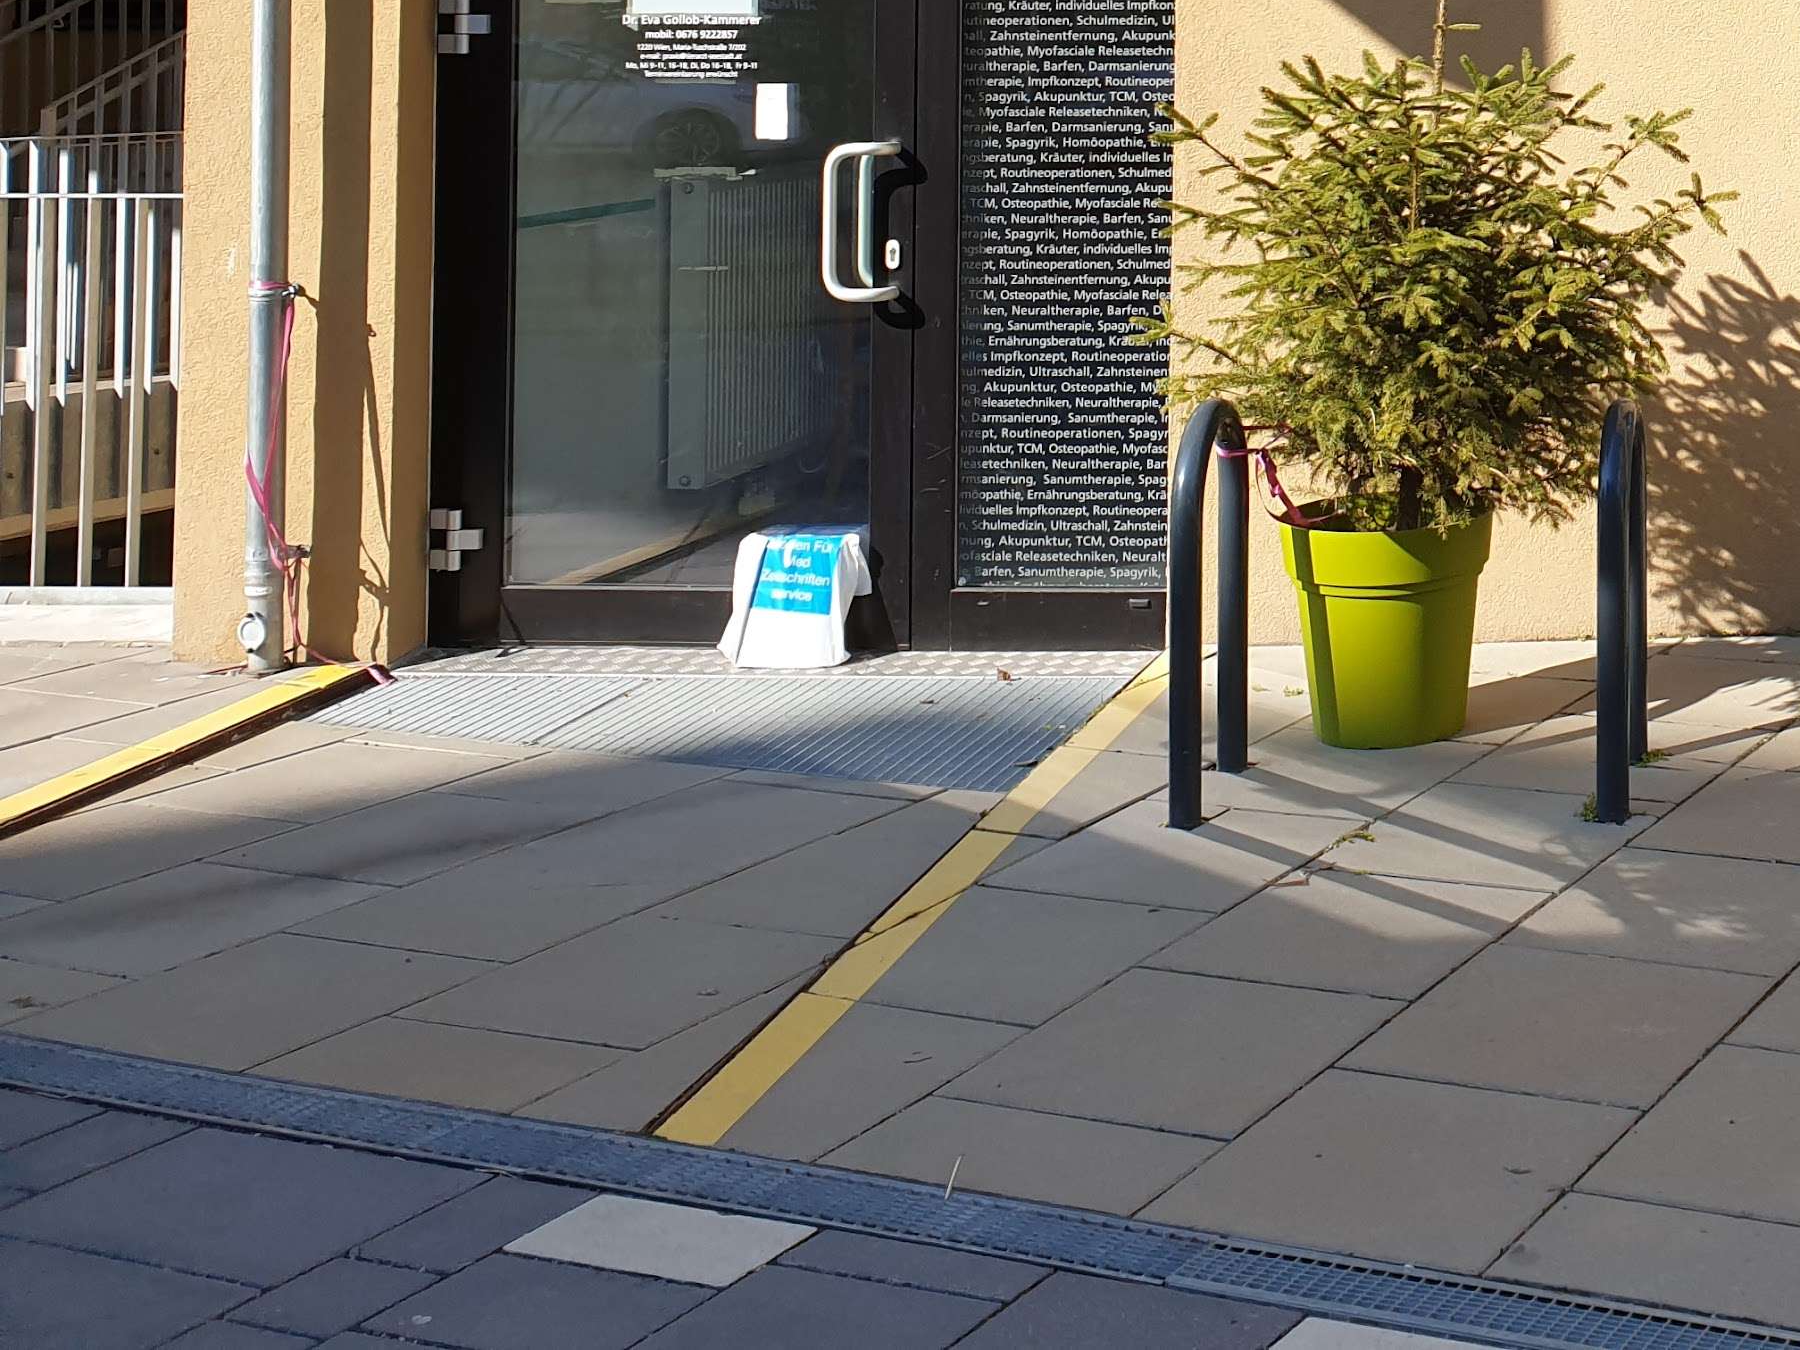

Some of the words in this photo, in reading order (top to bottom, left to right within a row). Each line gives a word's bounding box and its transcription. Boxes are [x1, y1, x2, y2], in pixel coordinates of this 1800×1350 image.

[623, 15, 638, 25] Dr.
[642, 15, 660, 25] Eva
[1077, 14, 1158, 26] Schulmedizin,
[646, 30, 674, 39] mobil:
[676, 31, 698, 39] 0676
[990, 30, 1117, 42] Zahnsteinentfernung,
[1028, 44, 1095, 57] Myofasciale
[1028, 74, 1101, 87] Impfkonzept,
[1034, 90, 1105, 102] Akupunktur,
[1109, 90, 1138, 102] TCM,
[1049, 104, 1150, 117] Releasetechniken,
[1006, 120, 1047, 133] Barfen,
[1052, 120, 1144, 133] Darmsanierung,
[1041, 150, 1085, 163] Kräuter,
[1089, 150, 1160, 161] individuelles
[1001, 166, 1114, 179] Routineoperationen,
[1002, 196, 1072, 209] Osteopathie,
[1011, 212, 1099, 225] Neuraltherapie,
[1104, 212, 1144, 224] Barfen,
[1005, 228, 1058, 240] Spagyrik,
[1063, 228, 1147, 240] Homöopathie,
[1011, 272, 1130, 285] Zahnsteinentfernung,
[1012, 304, 1102, 316] Neuraltherapie,
[1108, 304, 1148, 316] Barfen,
[1008, 320, 1094, 332] Sanumtherapie,
[989, 334, 1105, 347] Ernährungsberatung,
[1030, 364, 1092, 377] Ultraschall,
[984, 380, 1057, 393] Akupunktur,
[1061, 380, 1136, 393] Osteopathie,
[1002, 426, 1124, 439] Routineoperationen,
[1053, 458, 1142, 470] Neuraltherapie,
[1044, 472, 1134, 485] Sanumtherapie,
[1027, 488, 1144, 501] Ernährungsberatung,
[999, 534, 1071, 547] Akupunktur,
[1076, 534, 1105, 546] TCM,
[1016, 550, 1118, 562] Releasetechniken,
[1018, 566, 1106, 578] Sanumtherapie,
[1110, 566, 1160, 578] Spagyrik,
